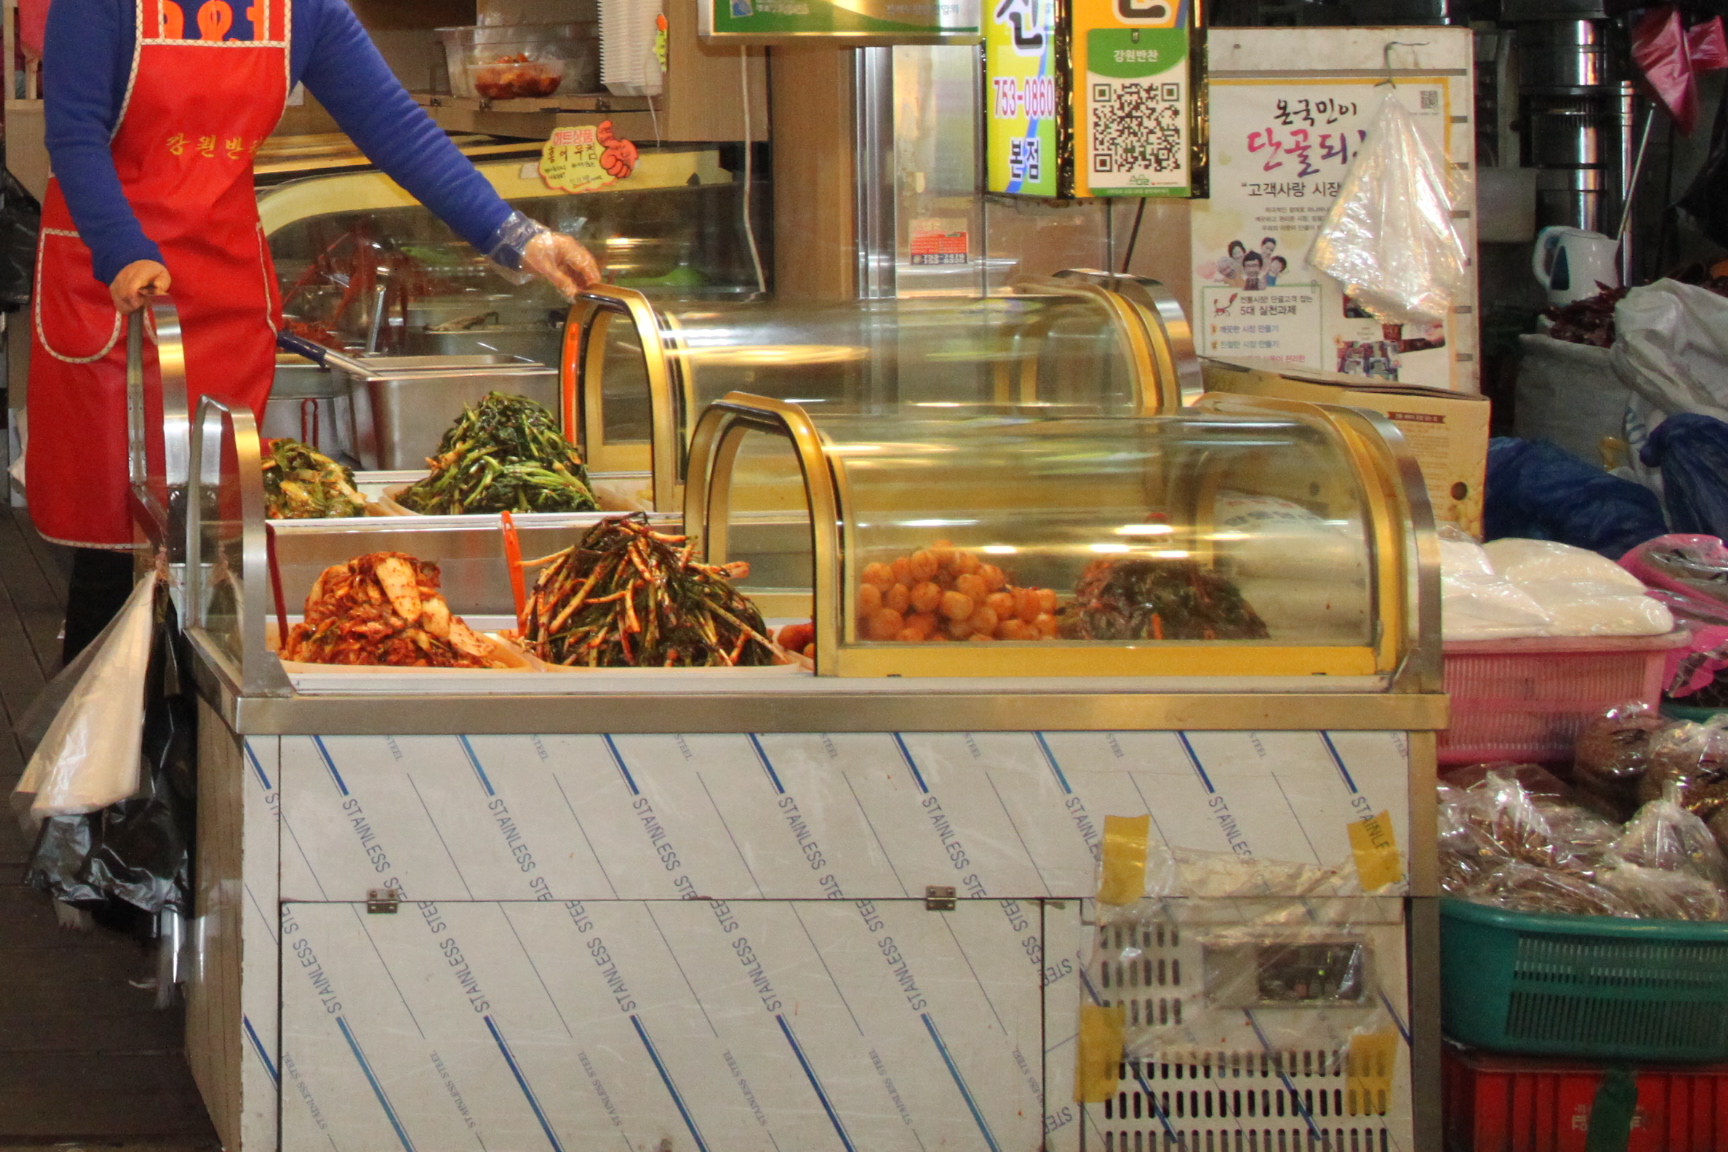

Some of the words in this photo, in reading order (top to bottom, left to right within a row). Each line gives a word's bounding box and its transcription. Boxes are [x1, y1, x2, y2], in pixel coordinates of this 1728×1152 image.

[1113, 49, 1159, 64] 강원반찬
[993, 79, 1054, 117] 753-0860
[1273, 97, 1357, 127] 온국민이
[1008, 138, 1040, 183] 본점
[342, 797, 391, 874] STAINLESS
[488, 797, 536, 874] STAINLESS
[632, 797, 681, 872] STAINLESS
[778, 796, 827, 871] STAINLESS
[922, 796, 970, 871] STAINLESS
[292, 937, 343, 1015] STAINLESS
[439, 936, 490, 1014] STAINLESS
[586, 935, 637, 1014] STAINLESS
[731, 936, 783, 1013] STAINLESS
[878, 935, 928, 1013] STAINLESS
[296, 1080, 328, 1130] STAINLESS
[442, 1079, 476, 1129] STAINLESS
[591, 1078, 624, 1128] STAINLESS
[737, 1078, 769, 1128] STAINLESS
[882, 1077, 914, 1126] STAINLESS
